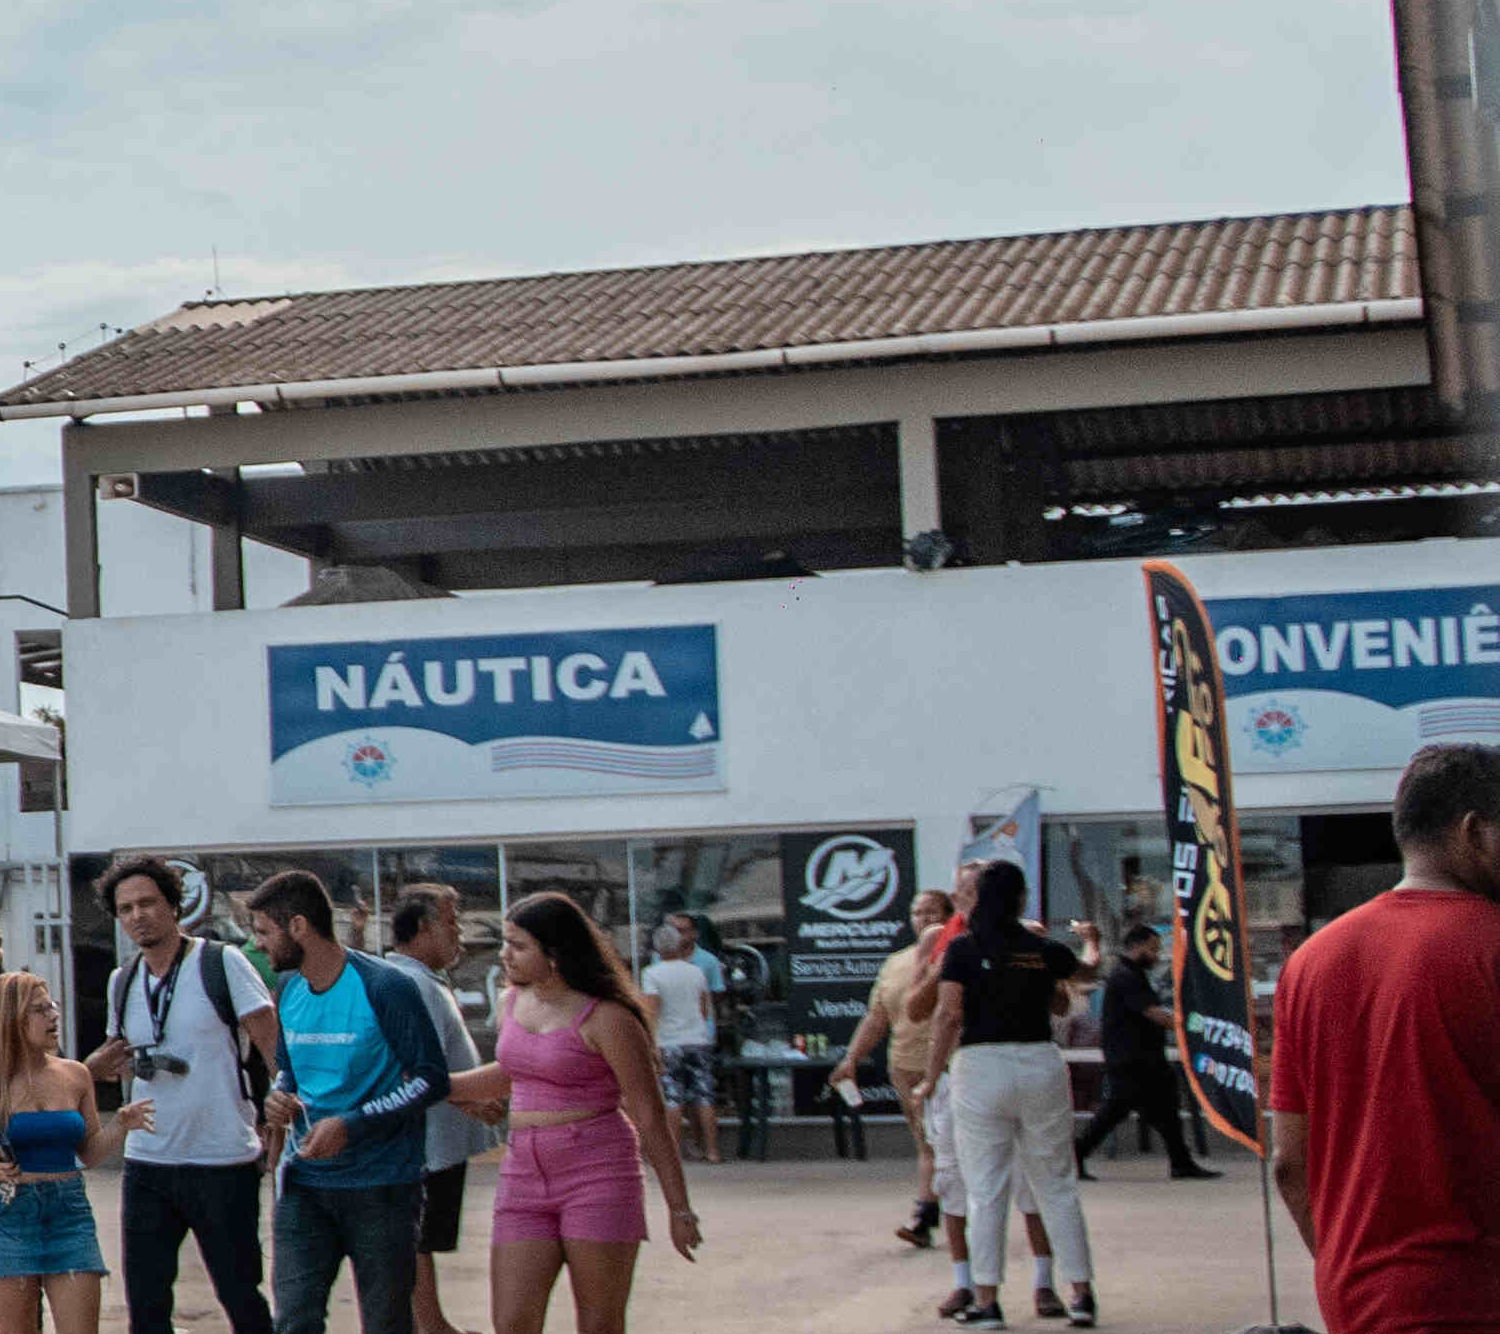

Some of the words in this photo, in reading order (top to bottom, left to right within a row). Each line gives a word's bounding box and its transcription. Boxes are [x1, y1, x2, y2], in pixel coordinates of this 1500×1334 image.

[1215, 603, 1500, 676] ONVENIÊ
[315, 650, 668, 712] NÁUTICA
[799, 920, 904, 937] MERCURY
